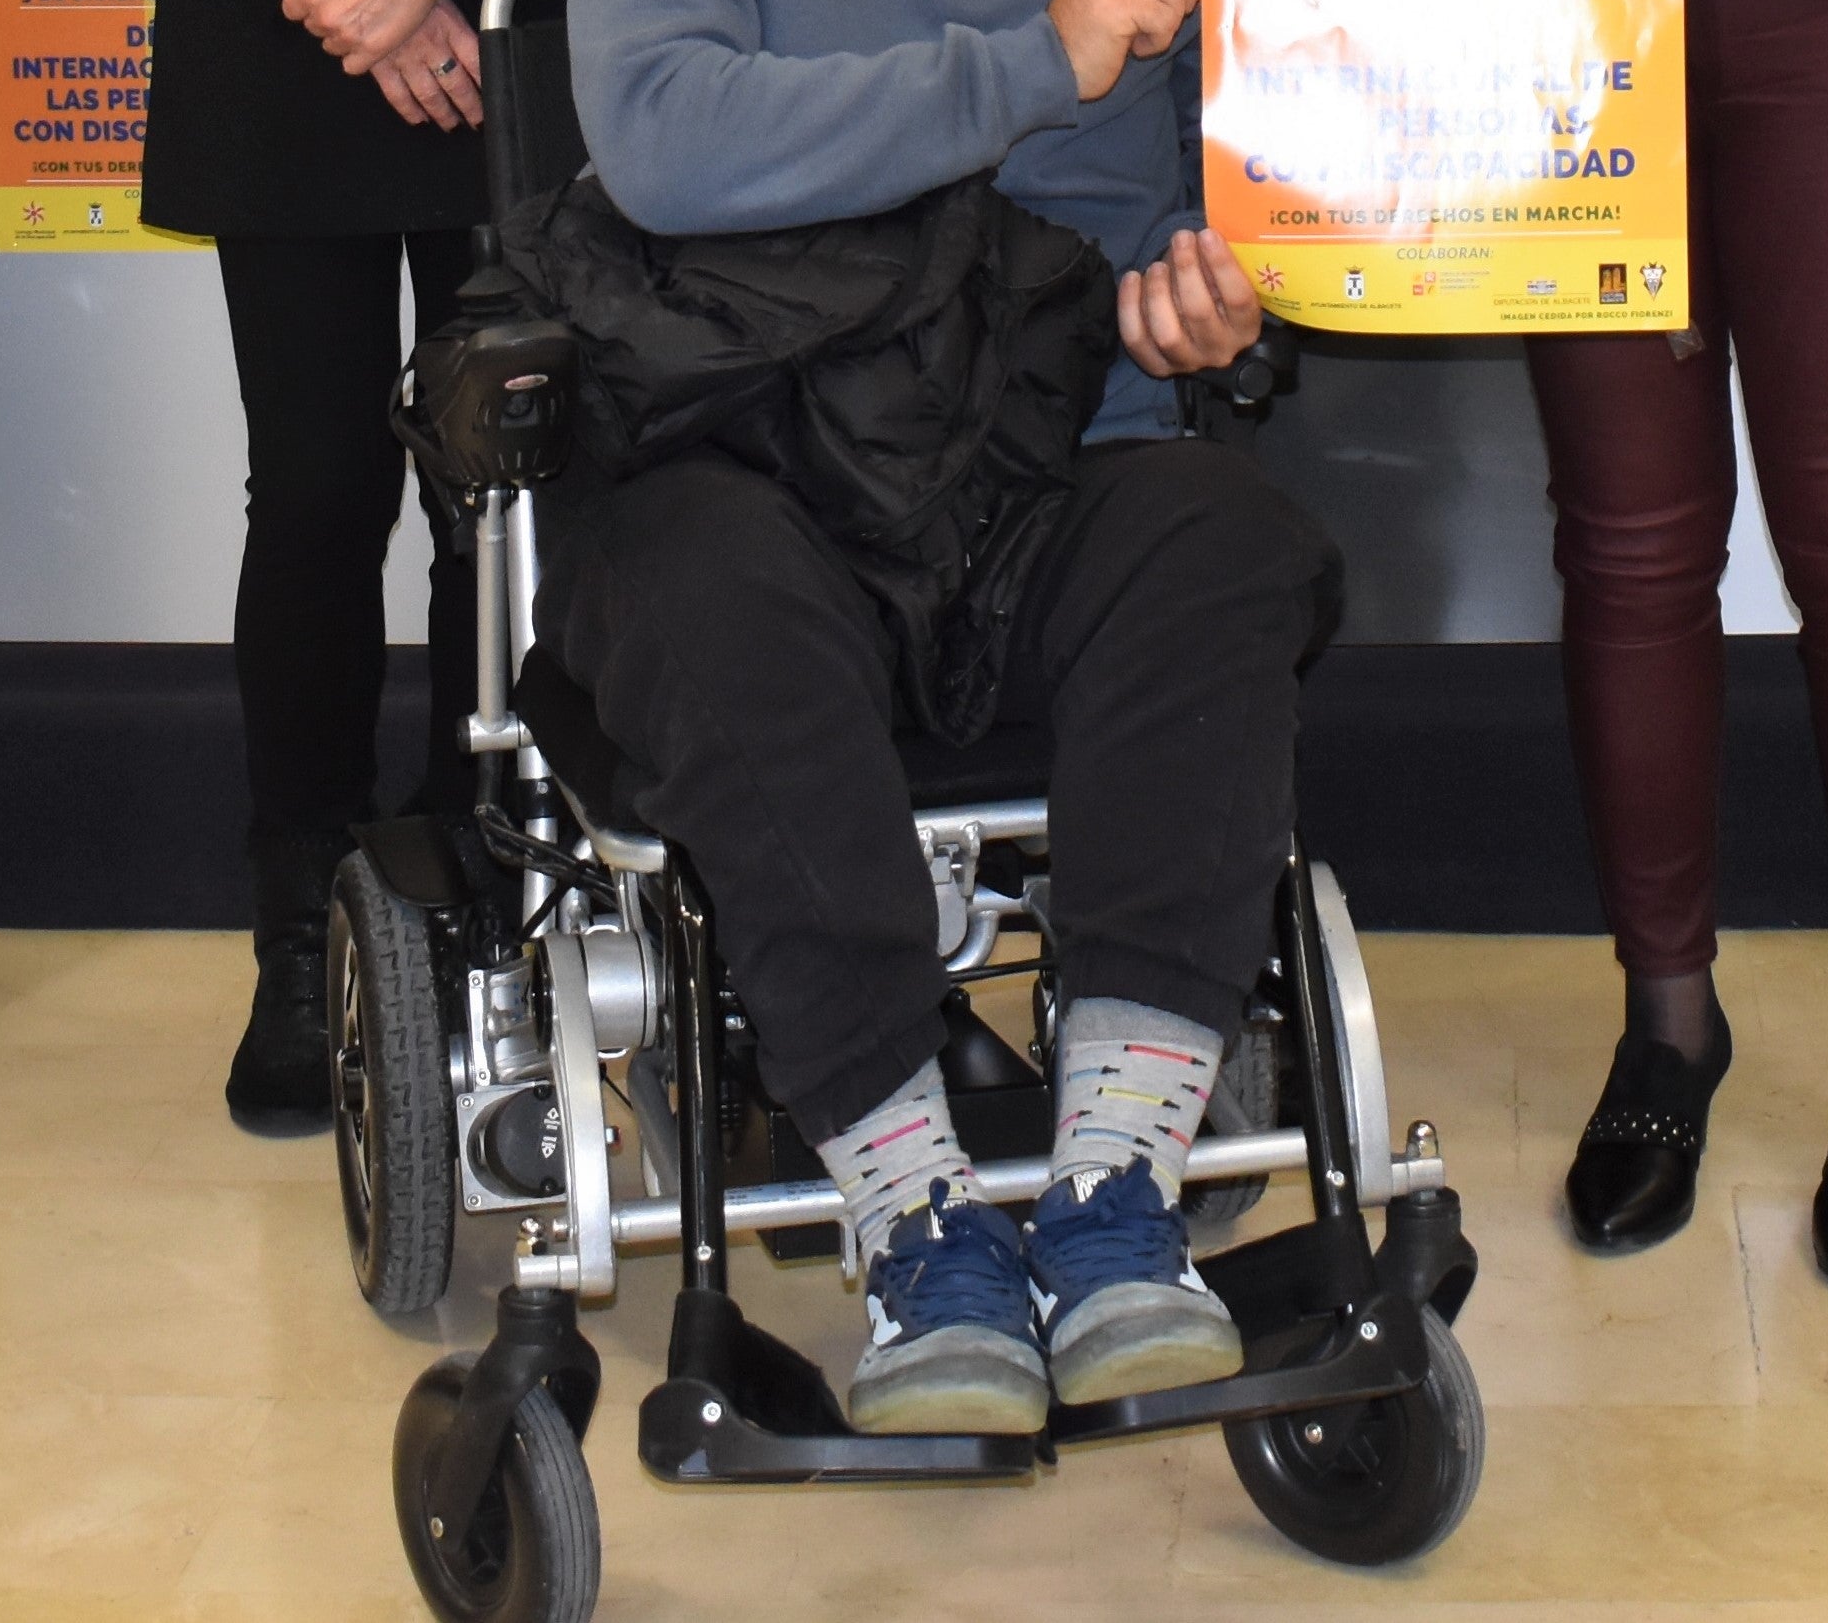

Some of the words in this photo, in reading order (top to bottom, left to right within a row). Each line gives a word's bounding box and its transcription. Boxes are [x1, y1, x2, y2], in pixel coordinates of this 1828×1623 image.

[13, 56, 153, 80] INTERNAC
[47, 88, 100, 111] LAS
[14, 120, 74, 142] CON
[82, 120, 147, 142] DISC
[74, 161, 103, 173] TUS
[1270, 210, 1320, 225] ¡CON
[1328, 209, 1367, 224] TUS
[1375, 207, 1485, 224] DERECHOS
[1492, 207, 1518, 222] EN
[1526, 205, 1621, 221] MARCHA!
[1539, 312, 1572, 320] CEDIDA
[1575, 311, 1593, 319] POR
